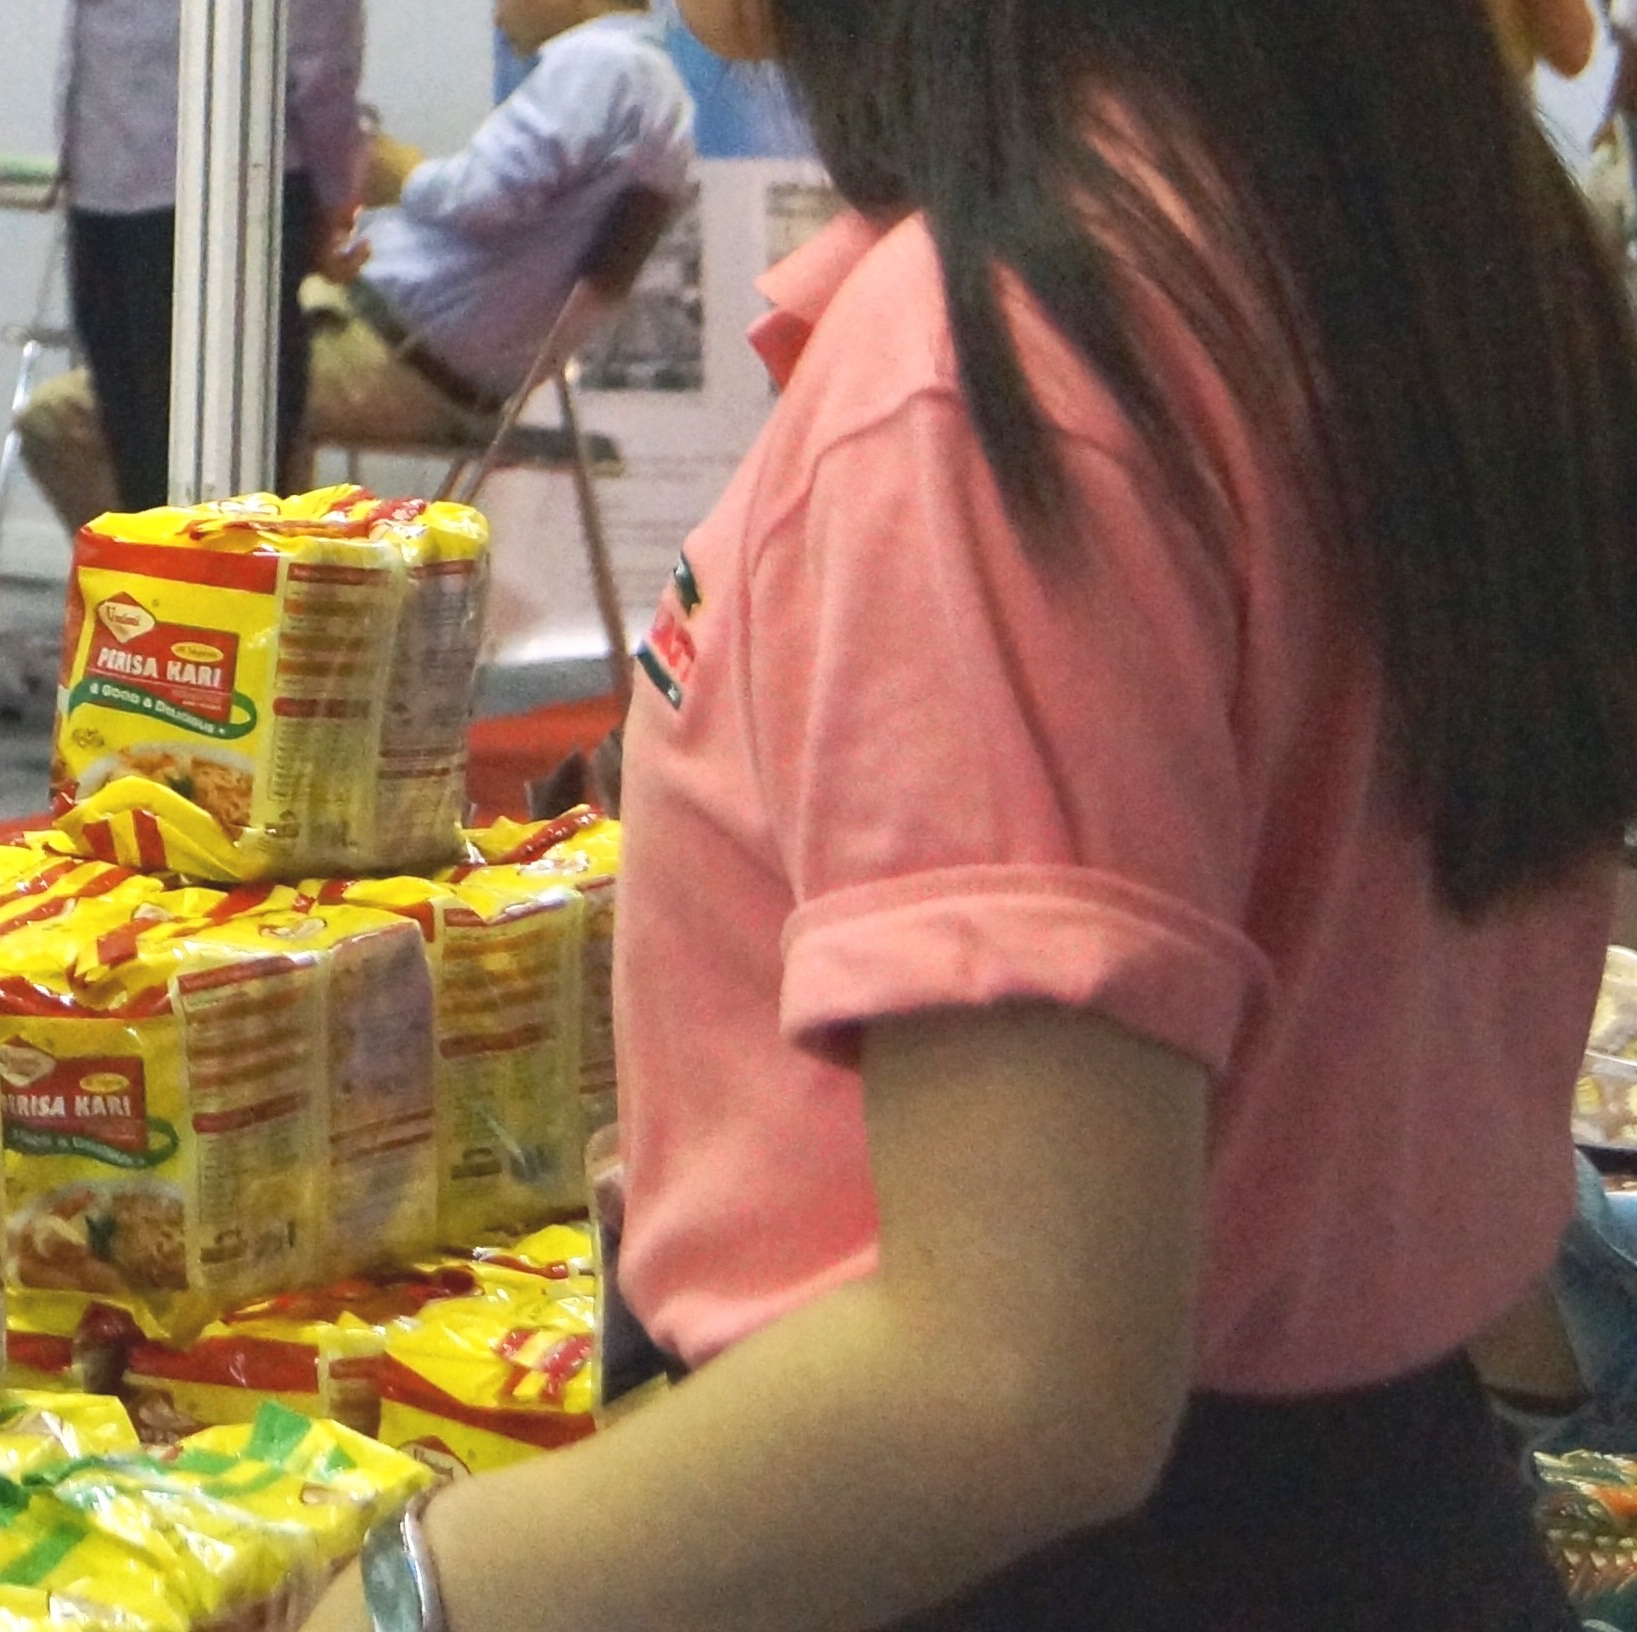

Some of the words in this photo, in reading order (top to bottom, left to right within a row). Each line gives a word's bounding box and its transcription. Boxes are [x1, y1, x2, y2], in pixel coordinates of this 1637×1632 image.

[96, 647, 159, 679] PERISA
[166, 659, 223, 688] KARI
[1, 1093, 67, 1117] ERISA
[75, 1094, 132, 1117] KARI
